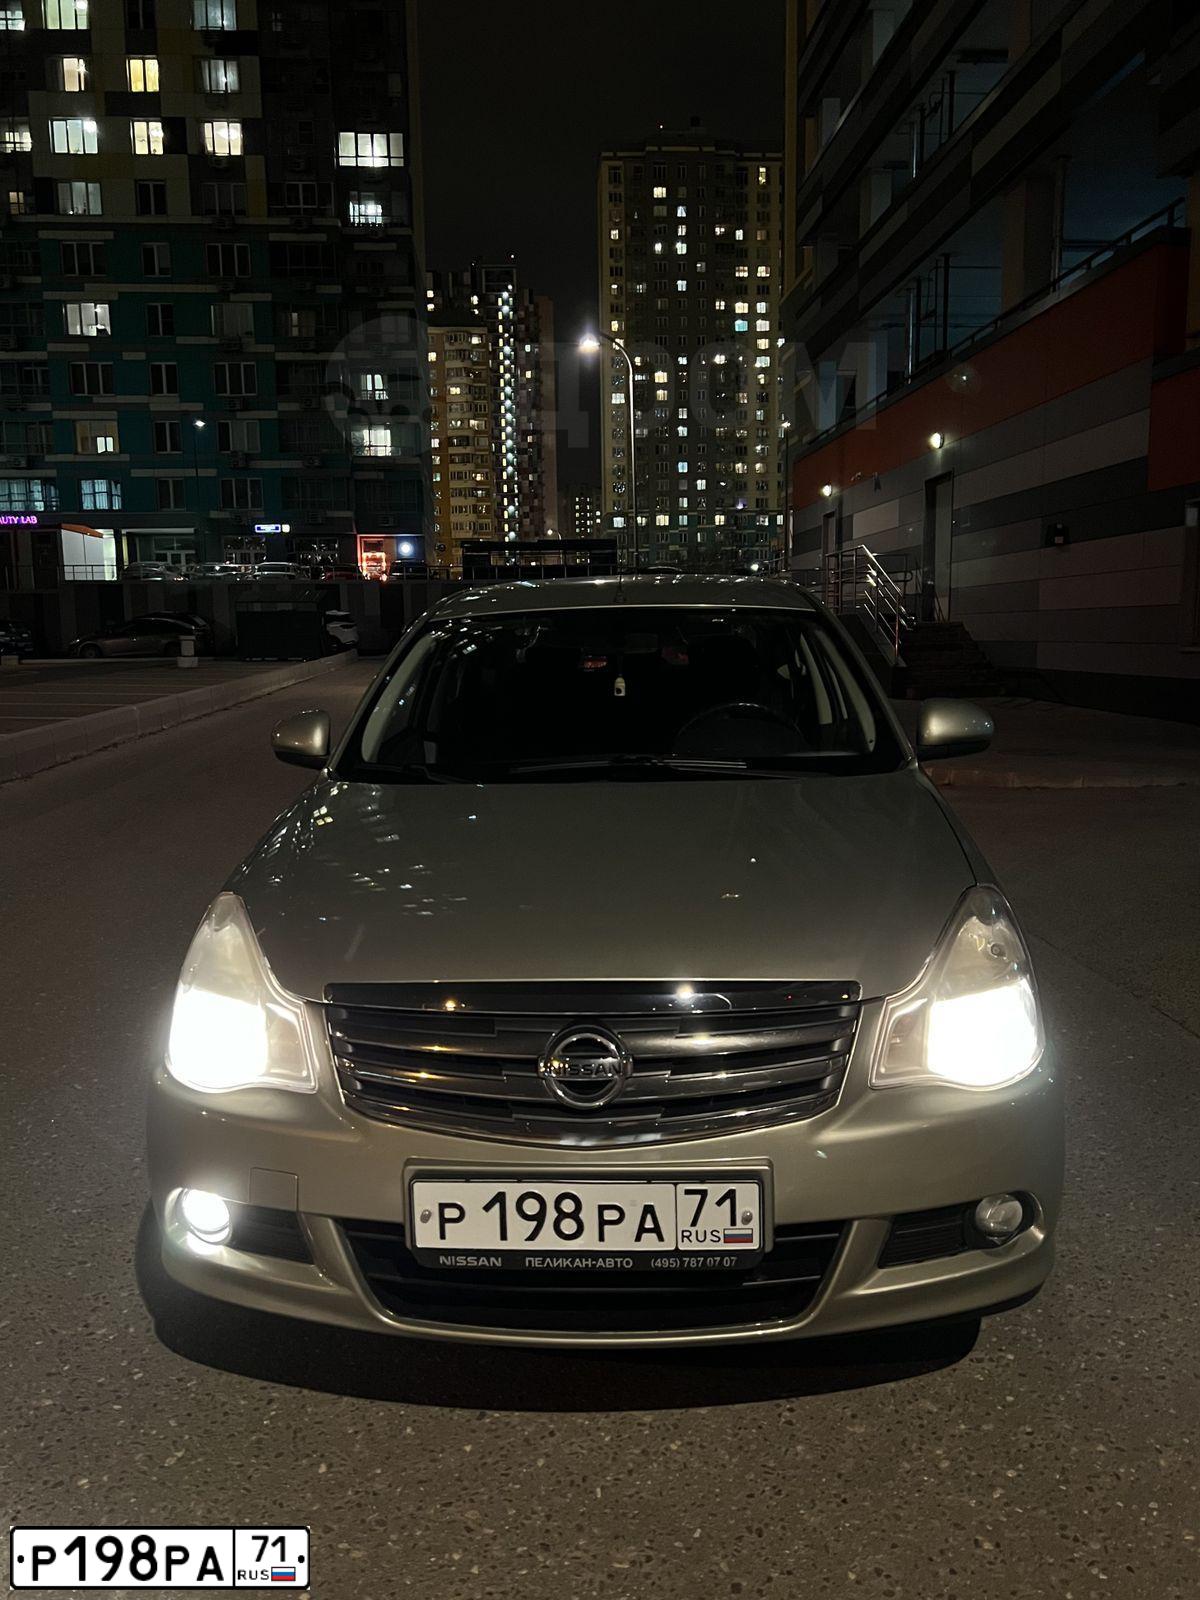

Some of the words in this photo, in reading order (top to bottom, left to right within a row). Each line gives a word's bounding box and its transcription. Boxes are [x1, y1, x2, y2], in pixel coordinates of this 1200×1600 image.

[20, 515, 38, 525] LAB
[683, 1188, 737, 1228] 71
[680, 1229, 722, 1244] RUS
[438, 1255, 502, 1267] NISSAN
[524, 1257, 634, 1268] ПЕЛИКАН-АВТО
[651, 1257, 680, 1268] (495)
[683, 1257, 704, 1268] 787
[707, 1256, 721, 1267] 07
[723, 1256, 738, 1267] 07
